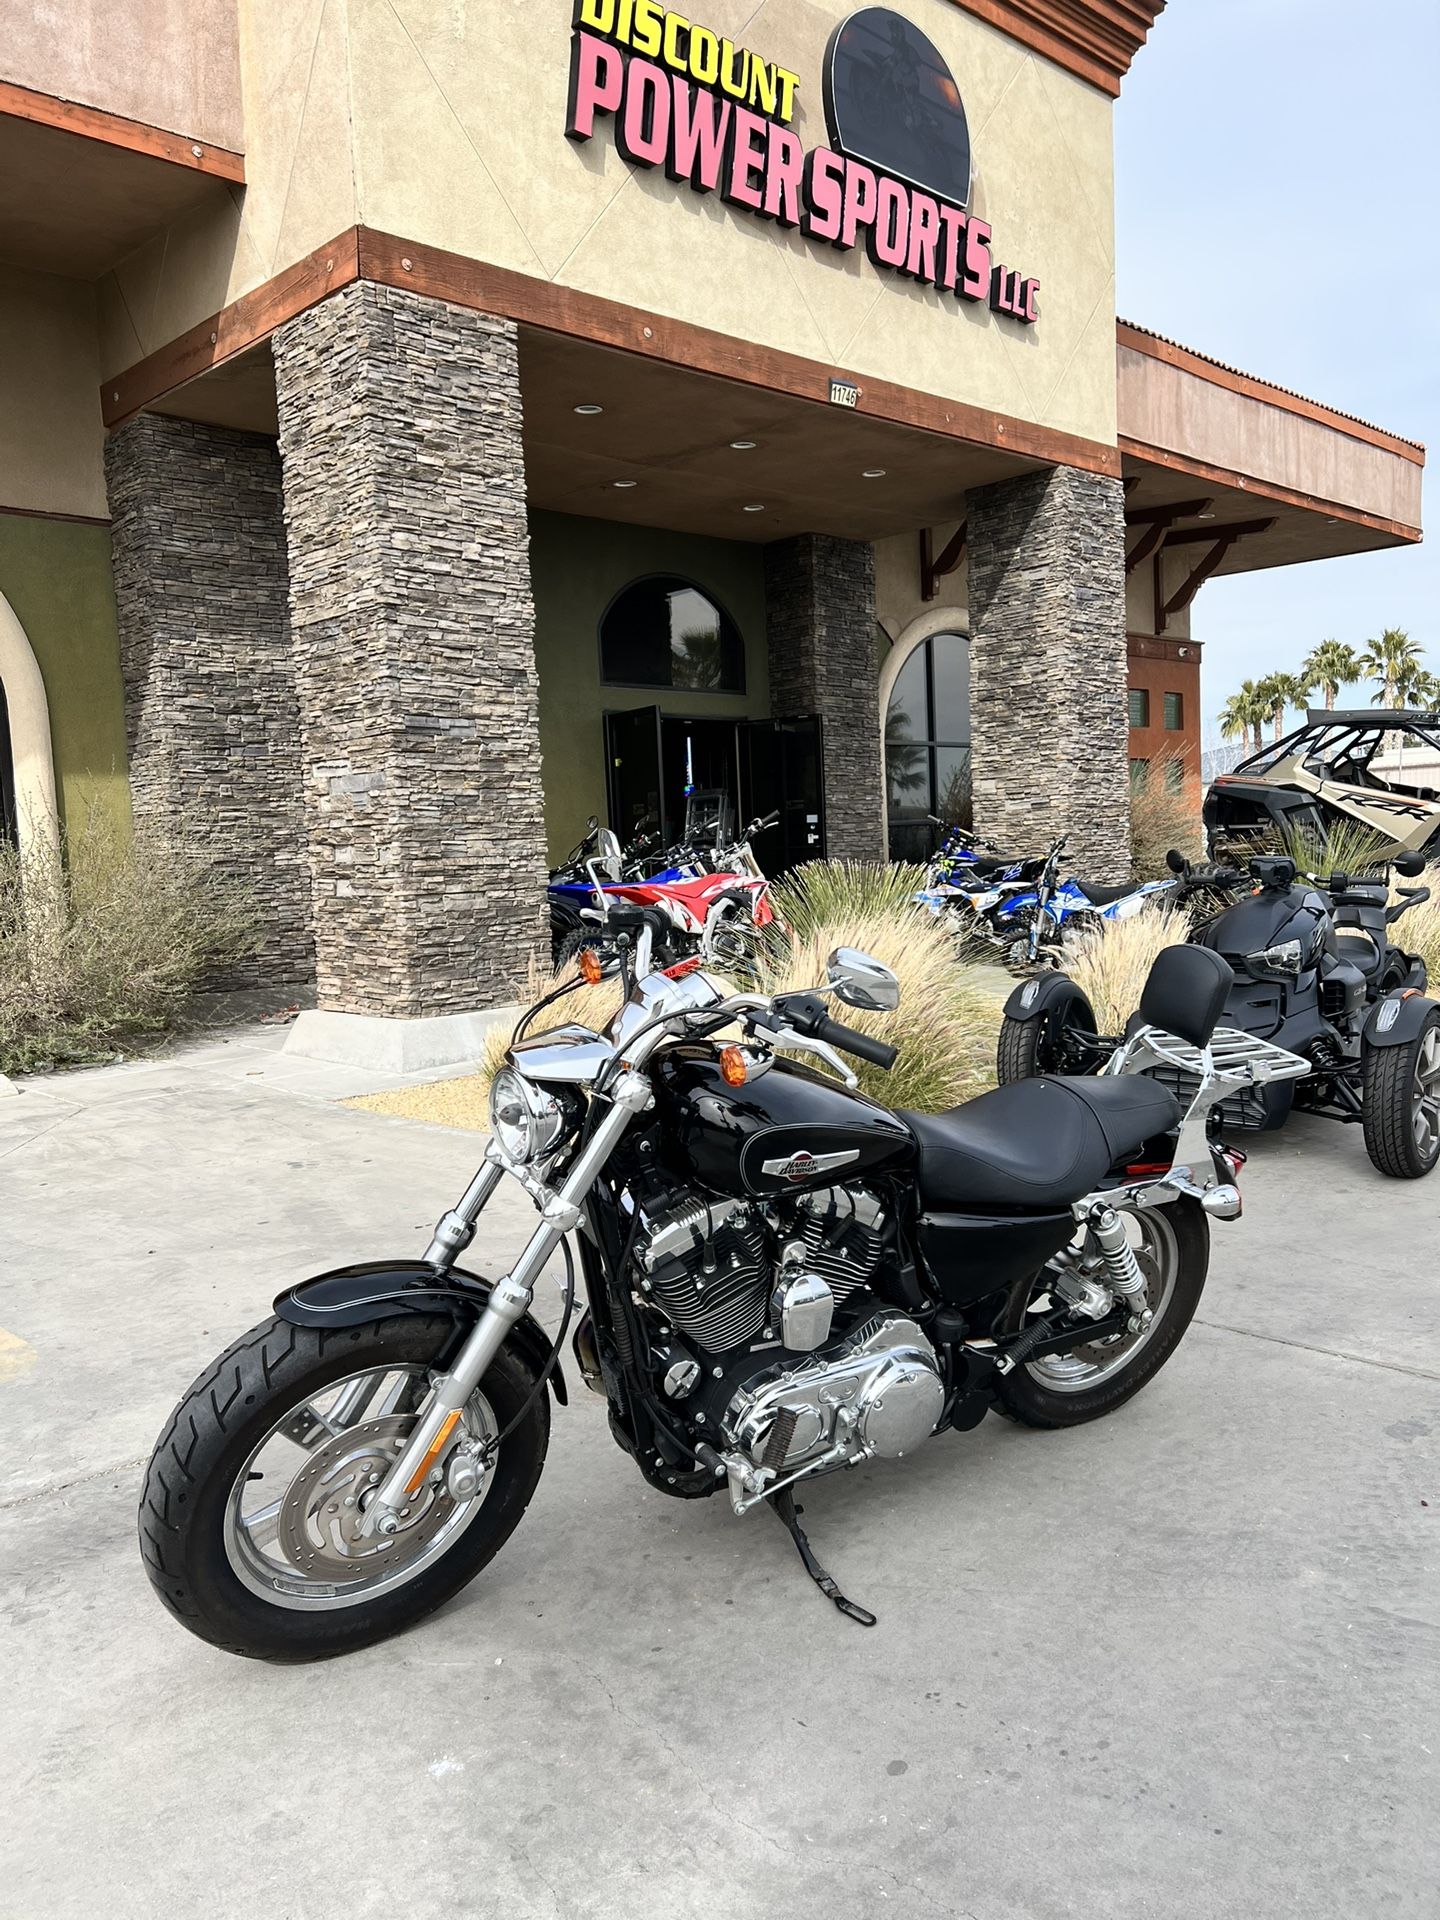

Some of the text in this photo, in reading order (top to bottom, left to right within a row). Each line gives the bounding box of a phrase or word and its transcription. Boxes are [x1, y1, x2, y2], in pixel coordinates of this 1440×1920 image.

[998, 265, 1041, 322] LLC
[832, 385, 857, 405] 11746
[1336, 793, 1435, 822] RZR
